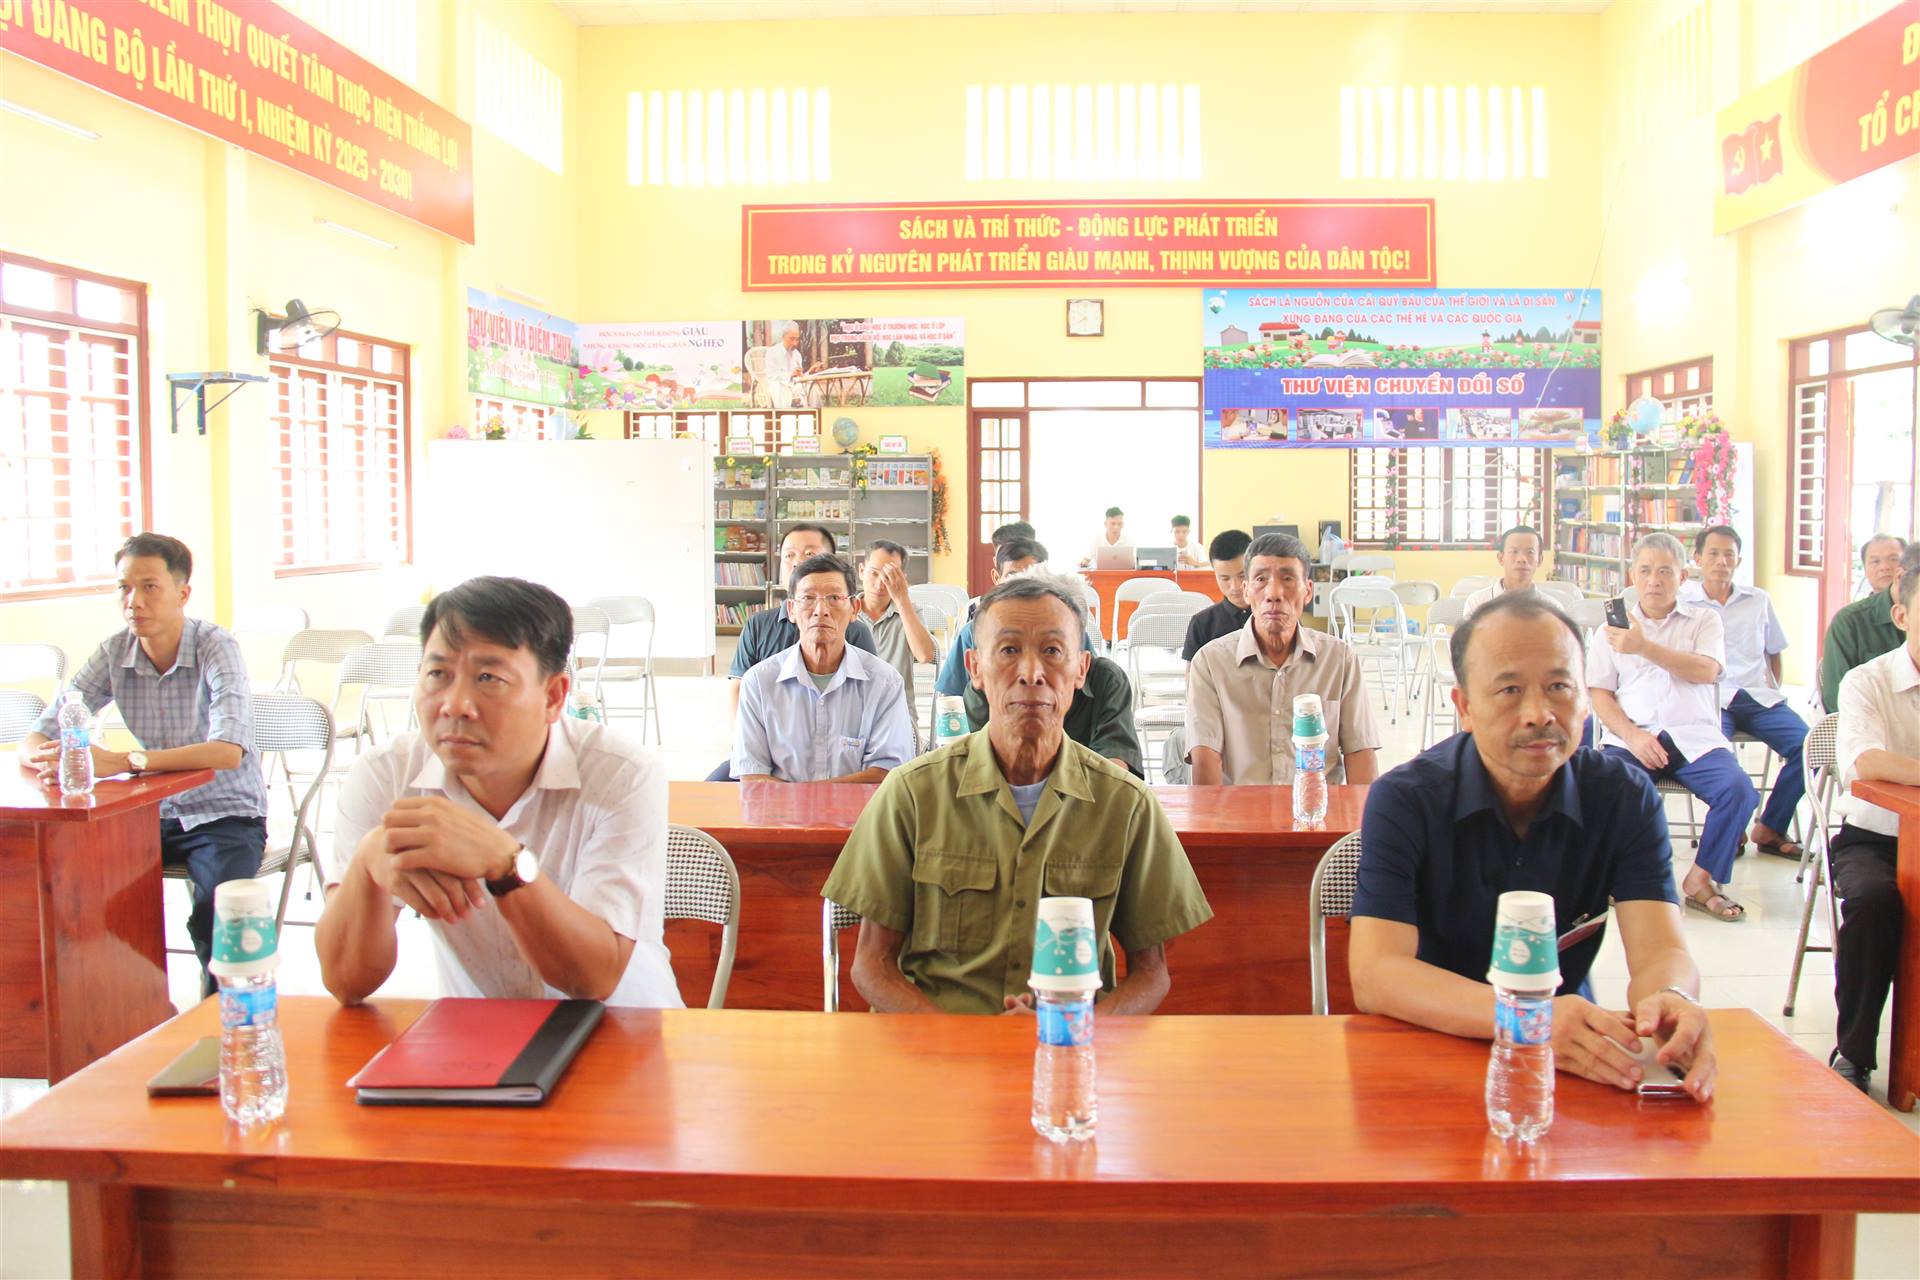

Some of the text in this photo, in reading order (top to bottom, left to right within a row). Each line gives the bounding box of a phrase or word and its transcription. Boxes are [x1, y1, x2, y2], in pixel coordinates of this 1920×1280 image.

[247, 24, 299, 84] QUYẾT
[302, 53, 333, 103] TÂM
[336, 75, 371, 125] THỰC
[373, 96, 402, 141] HIỆN
[404, 112, 441, 160] THẮNG
[114, 28, 146, 91] BỘ
[152, 40, 195, 103] LẦN
[199, 68, 238, 121] THỨ
[240, 89, 253, 134] I,
[257, 97, 310, 156] NHIỆM
[313, 123, 333, 164] KỲ
[335, 137, 369, 181] 2025
[380, 159, 413, 201] 2030!
[900, 216, 947, 239] SÁCH
[953, 215, 976, 238] VÀ
[981, 214, 1009, 238] TRÍ
[1015, 214, 1060, 237] THỨC
[1079, 214, 1129, 241] ĐỘNG
[1134, 215, 1168, 240] LỰC
[1174, 213, 1220, 237] PHÁT
[1225, 210, 1278, 237] TRIỂN
[768, 244, 1410, 275] TRONG KỶ NGUYÊN PHÁT TRIỂN GIÀU MẠNH, THỊNH VƯỢNG CỦA DÂN TỘC!
[1249, 294, 1276, 307] SÁCH
[1279, 294, 1291, 307] LÀ
[1294, 292, 1331, 307] NGUỒN
[1334, 294, 1356, 307] CỦA
[1402, 293, 1422, 307] BÁU
[1424, 293, 1445, 307] CỦA
[1449, 292, 1466, 307] THẾ
[1468, 293, 1490, 307] GIỚI
[467, 306, 488, 339] THƯ
[1282, 312, 1311, 323] XỨNG
[1314, 311, 1343, 323] ĐÁNG
[1346, 311, 1367, 323] CỦA
[1371, 312, 1393, 323] CÁC
[1396, 310, 1412, 323] THẾ
[1431, 311, 1443, 323] VÀ
[1447, 312, 1469, 323] CÁC
[1472, 310, 1502, 323] QUỐC
[1505, 314, 1523, 323] GIA
[1282, 372, 1526, 398] THƯ VIỆN CHUYỂN ĐỔI SỐ
